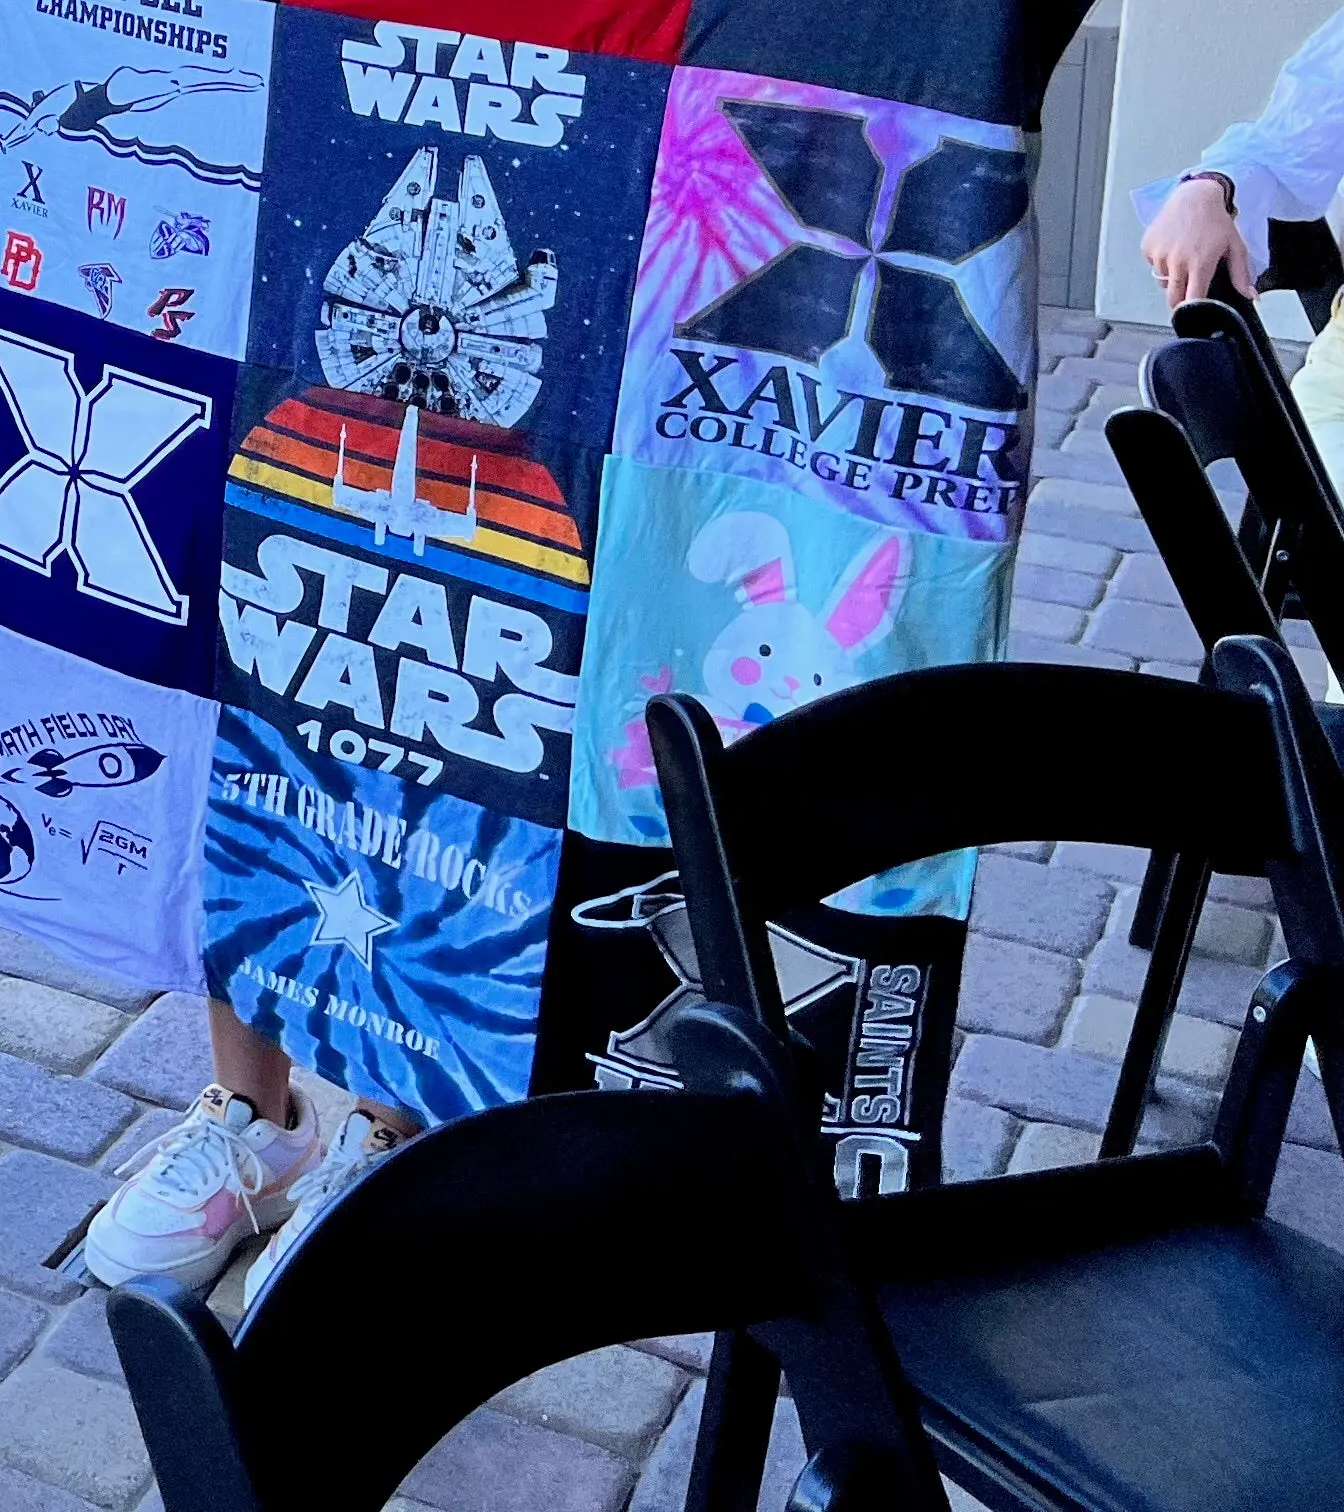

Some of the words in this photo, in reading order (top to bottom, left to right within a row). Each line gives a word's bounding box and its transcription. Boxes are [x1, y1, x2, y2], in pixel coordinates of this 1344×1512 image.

[341, 18, 587, 95] STAR
[341, 60, 587, 148] WARS
[10, 197, 49, 219] XAVIER
[654, 410, 874, 491] COLLEGE
[660, 348, 1019, 483] XAVIER
[219, 533, 579, 706] STAR
[40, 712, 100, 745] FIELD
[96, 713, 144, 745] DAY
[217, 586, 578, 775] WARS
[220, 772, 291, 817] 5TH
[297, 782, 407, 870] GRADE
[411, 828, 533, 921] ROCKS
[238, 956, 320, 1009] JAMES
[323, 993, 441, 1061] MONROE
[850, 963, 922, 1125] SAINTS
